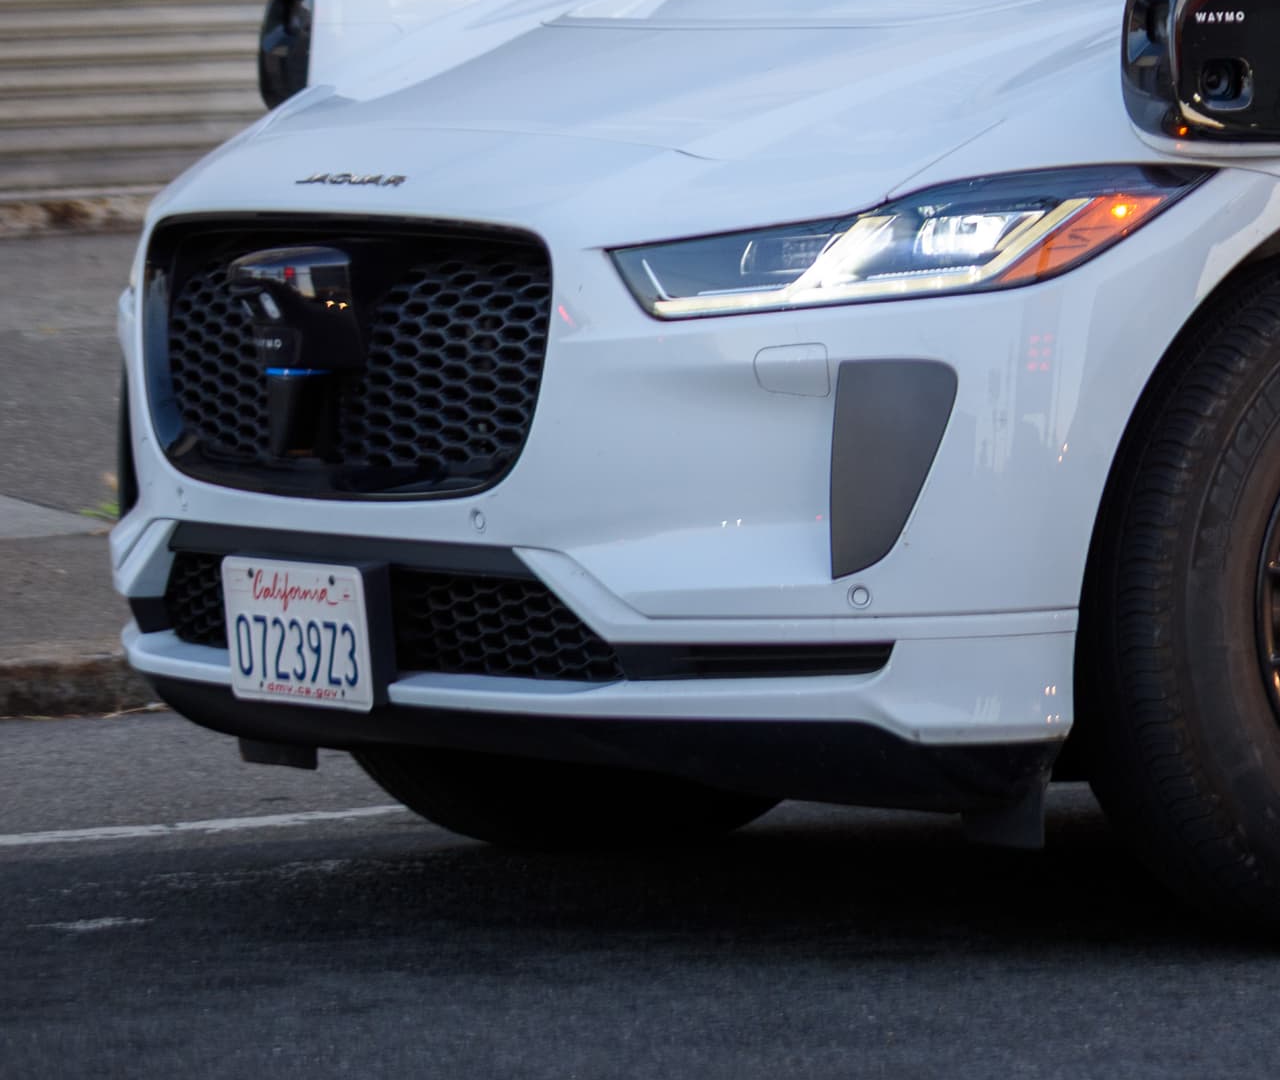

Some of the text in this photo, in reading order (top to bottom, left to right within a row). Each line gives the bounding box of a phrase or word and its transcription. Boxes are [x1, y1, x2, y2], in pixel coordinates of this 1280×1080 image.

[1195, 11, 1245, 22] WAYMO
[253, 569, 338, 612] California
[236, 613, 358, 687] 07239Z3
[267, 682, 338, 699] dmv.ca.gov
